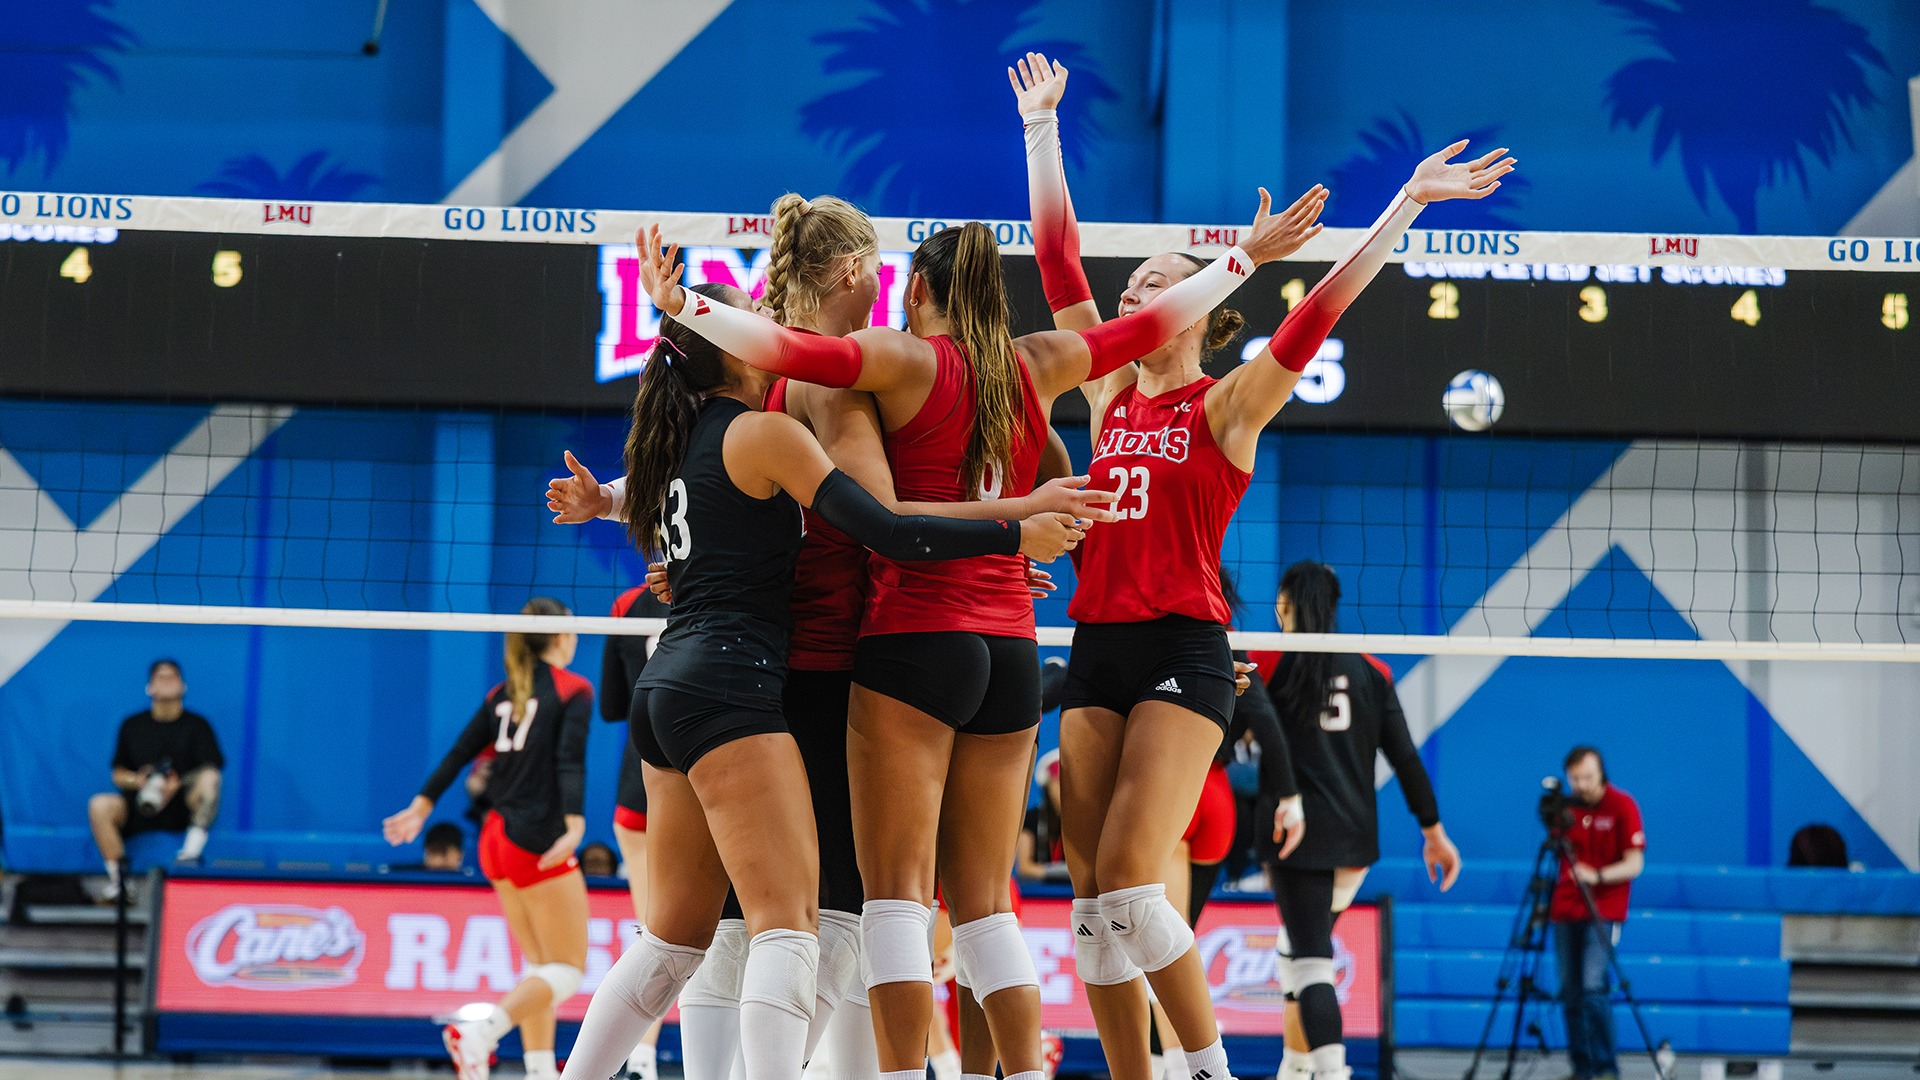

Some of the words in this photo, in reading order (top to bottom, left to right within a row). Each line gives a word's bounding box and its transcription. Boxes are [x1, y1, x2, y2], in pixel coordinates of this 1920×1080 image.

[36, 195, 132, 221] LIONS
[263, 203, 313, 226] LMU
[444, 208, 486, 231] GO
[500, 209, 598, 235] LIONS
[1188, 227, 1239, 248] LMU
[1425, 231, 1521, 256] LIONS
[1648, 236, 1700, 259] LMU
[1828, 239, 1870, 262] GO
[1884, 240, 1920, 262] LI
[60, 246, 93, 284] 4
[212, 249, 243, 288] 5
[1427, 282, 1460, 320] 2
[1578, 285, 1609, 324] 3
[1730, 289, 1762, 327] 4
[1880, 292, 1910, 330] 5
[1092, 426, 1191, 464] LIONS
[1108, 466, 1151, 520] 23
[1155, 685, 1182, 694] adidas
[1319, 674, 1351, 731] 5
[494, 698, 539, 753] 17
[195, 905, 361, 981] Cane's
